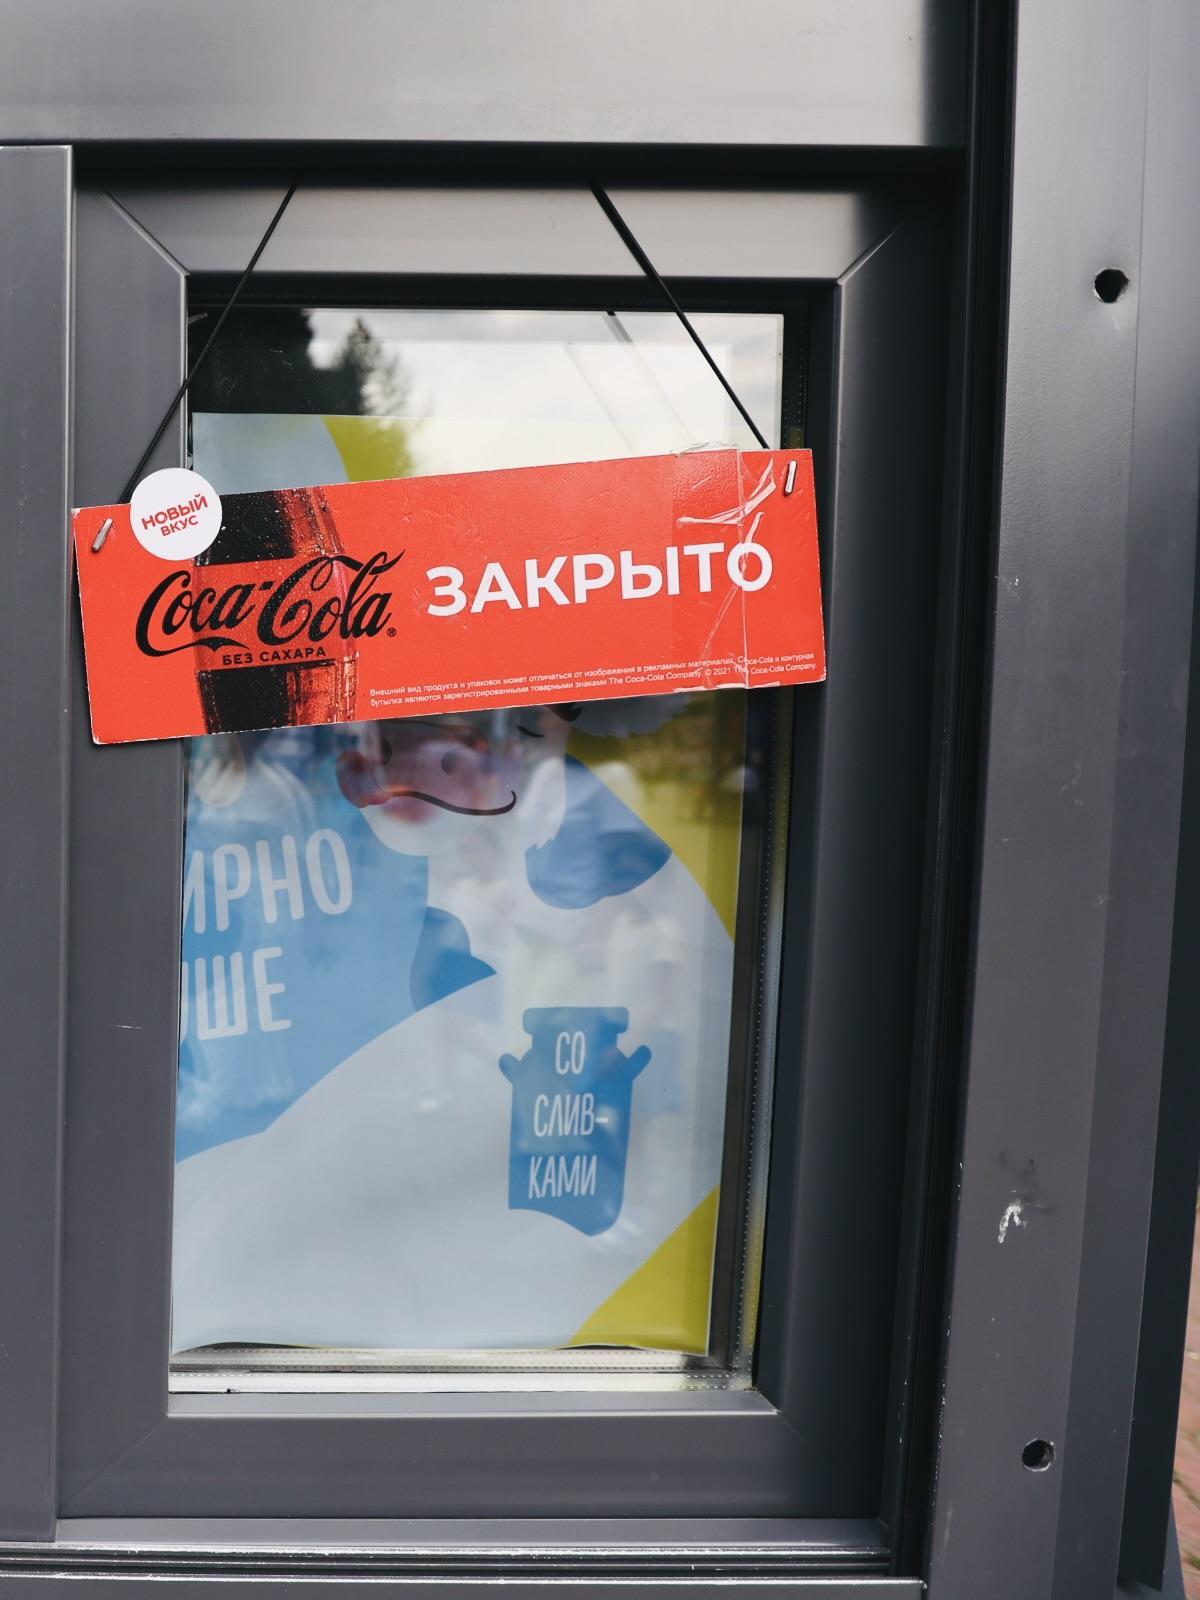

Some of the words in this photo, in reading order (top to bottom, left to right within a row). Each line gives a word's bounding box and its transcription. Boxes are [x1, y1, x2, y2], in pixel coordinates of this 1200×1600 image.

[141, 493, 209, 530] НОВЫЙ
[161, 515, 199, 537] ВКУС
[425, 541, 774, 618] ЗАКРЫТО
[135, 549, 406, 658] Coca-Cola
[222, 653, 254, 666] БЕЗ
[259, 646, 327, 663] САХАРА
[369, 687, 406, 697] Внешний
[407, 685, 423, 693] вид
[423, 682, 459, 694] продукта
[466, 678, 501, 689] упаковок
[503, 676, 527, 684] может
[528, 672, 573, 683] отличаться
[584, 665, 636, 678] изображения
[643, 663, 686, 674] рекламных
[781, 652, 815, 662] контурная
[370, 696, 403, 707] бутылка
[404, 693, 442, 704] являются
[443, 686, 528, 701] зарегистрированными
[531, 682, 574, 693] товарными
[575, 679, 608, 689] знаками
[609, 675, 624, 684] The
[625, 672, 665, 683] Coca-Cola
[713, 667, 731, 675] 2021
[751, 665, 785, 675] Coca-Cola
[786, 662, 817, 673] Company.
[556, 1031, 586, 1075] СО
[533, 1093, 609, 1138] СЛИВ-
[529, 1155, 597, 1200] КАМИ
